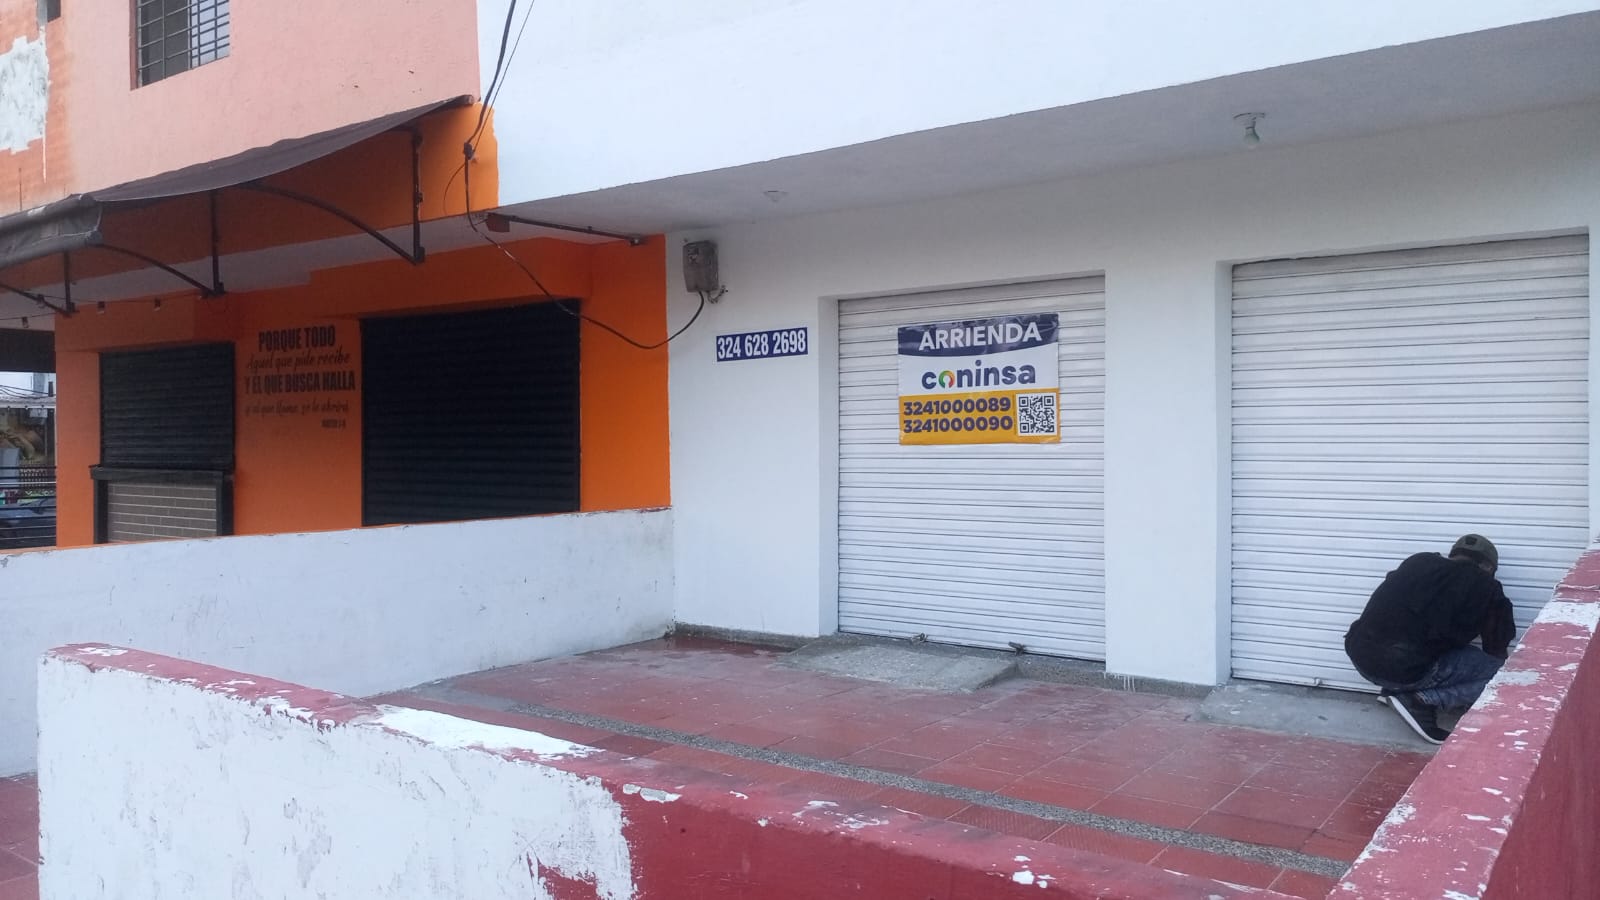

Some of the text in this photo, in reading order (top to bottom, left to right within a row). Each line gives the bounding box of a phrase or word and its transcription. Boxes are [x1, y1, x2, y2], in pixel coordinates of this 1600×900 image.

[258, 325, 336, 352] PORQUE TODO
[717, 329, 806, 359] 324 628 2698
[918, 322, 1042, 351] ARRIENDA
[275, 357, 293, 372] que
[294, 348, 316, 371] pide
[318, 344, 350, 365] recibe
[244, 370, 356, 395] Y EL QUE BUSCA HALLA
[921, 359, 1036, 390] coninsa
[903, 396, 1011, 416] 3241000089
[903, 415, 1013, 433] 3241000090
